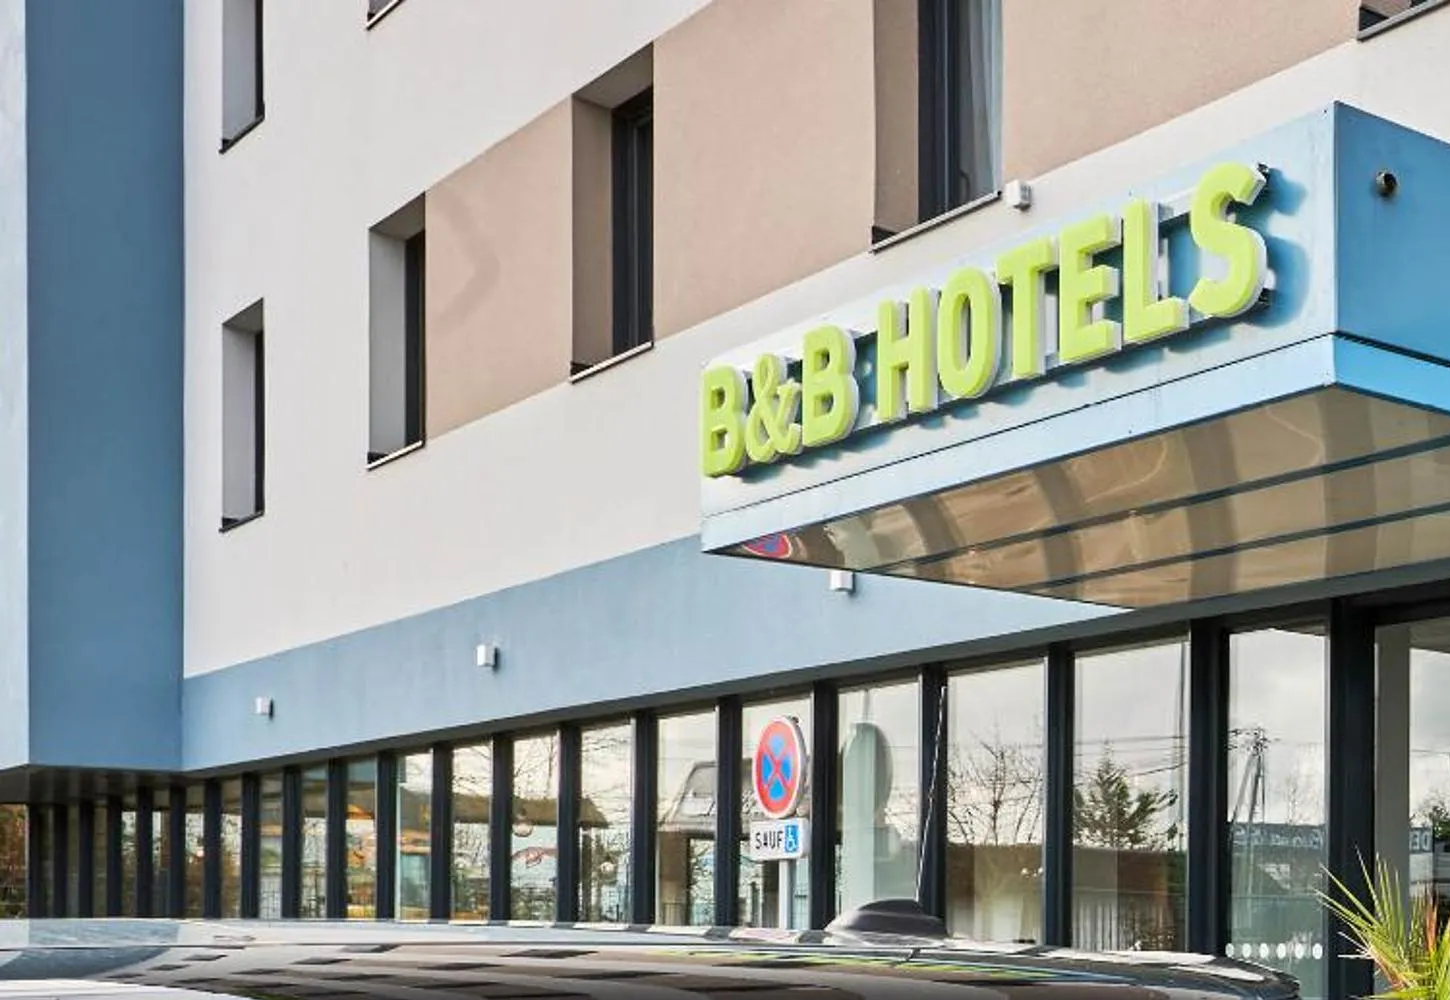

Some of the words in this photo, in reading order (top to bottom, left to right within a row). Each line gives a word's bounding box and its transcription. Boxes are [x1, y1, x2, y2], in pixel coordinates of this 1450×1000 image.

[702, 325, 857, 476] B&B
[877, 162, 1267, 422] HOTELS
[755, 830, 783, 849] SAUF
